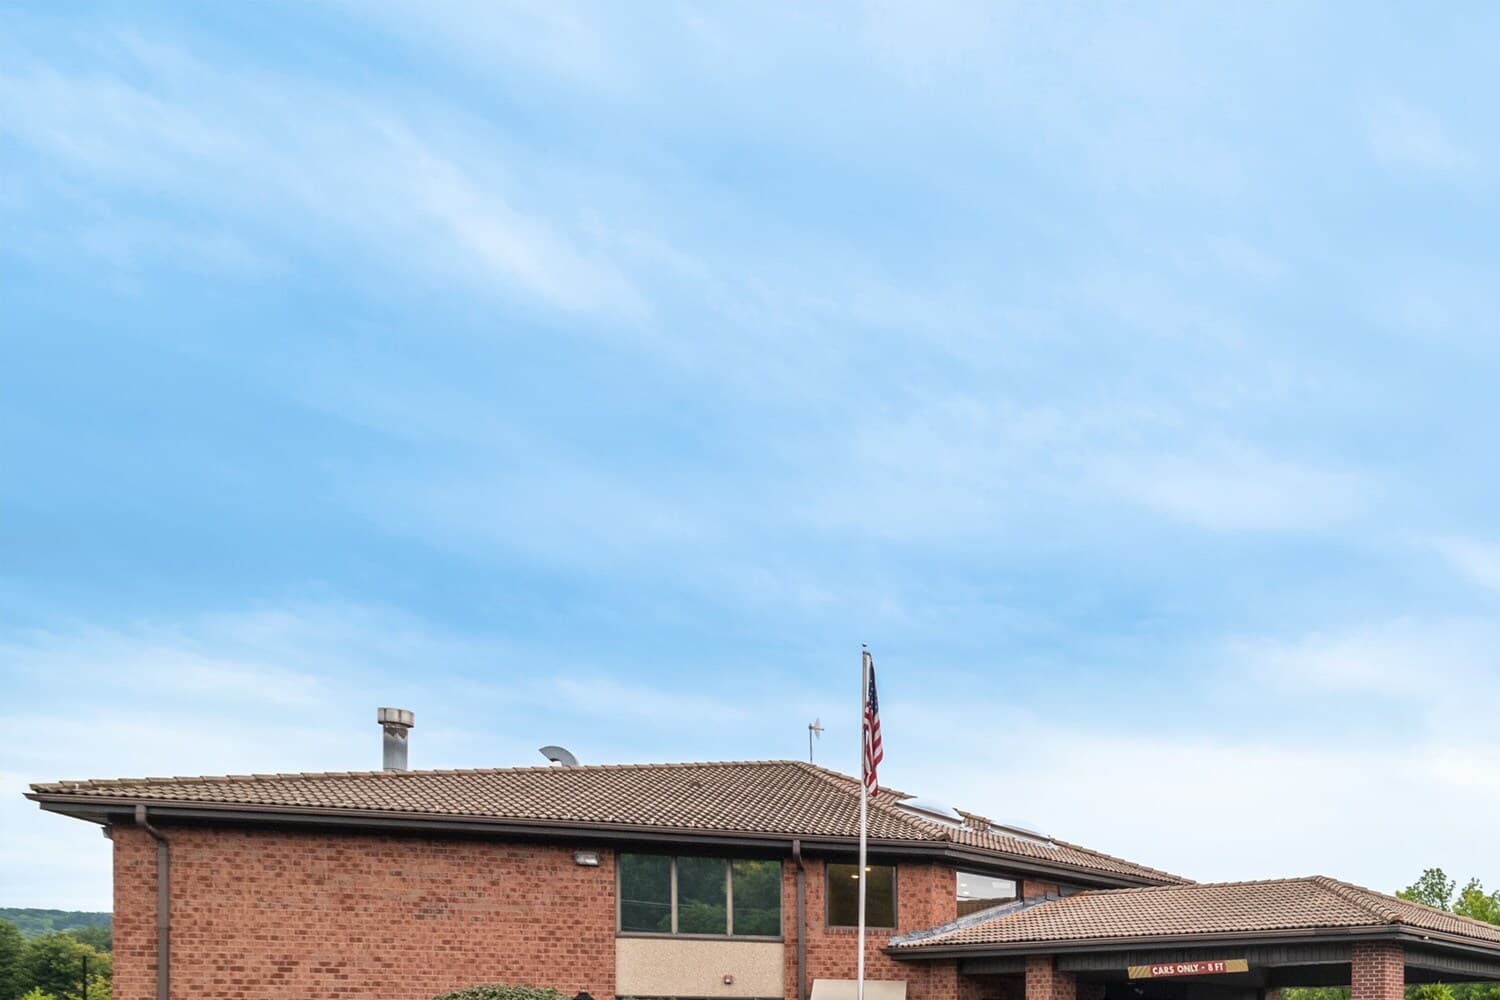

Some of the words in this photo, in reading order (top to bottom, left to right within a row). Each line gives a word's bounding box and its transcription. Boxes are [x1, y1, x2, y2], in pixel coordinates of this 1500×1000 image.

[1152, 965, 1174, 975] CARS
[1177, 963, 1199, 973] ONLY
[1214, 962, 1223, 971] FT
